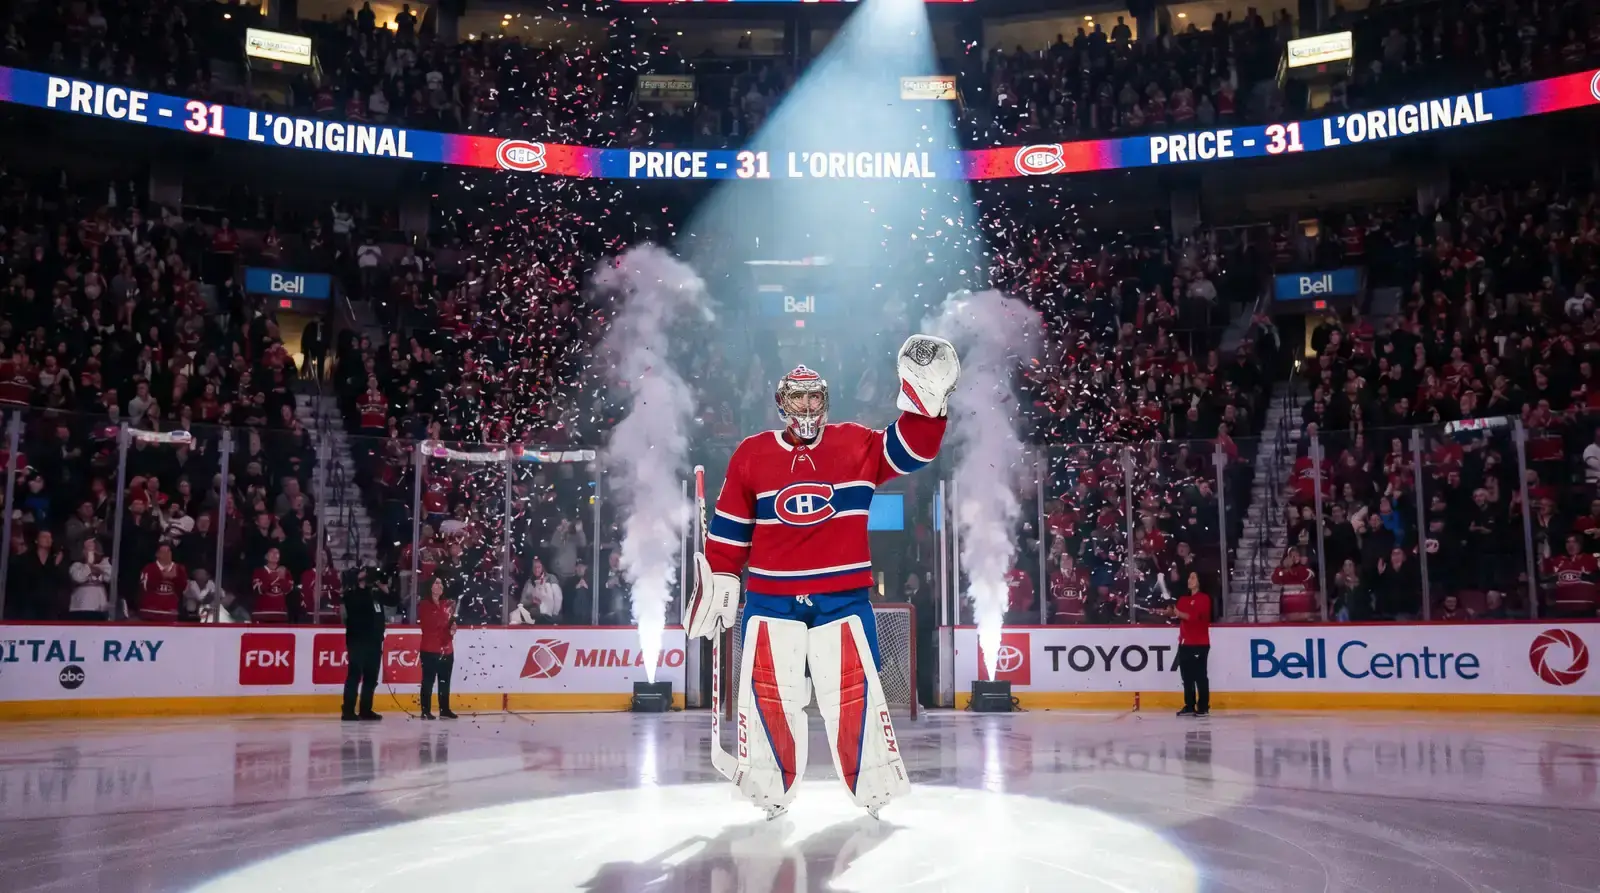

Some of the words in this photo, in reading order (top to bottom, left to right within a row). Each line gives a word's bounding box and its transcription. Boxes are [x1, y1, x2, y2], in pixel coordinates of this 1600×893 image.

[47, 77, 149, 123] PRICE
[185, 100, 226, 137] 31
[248, 111, 414, 159] L’ORIGINAL
[1150, 129, 1235, 164] PRICE
[1264, 121, 1304, 155] 31
[1322, 92, 1493, 147] L’ORIGINAL
[629, 151, 708, 178] PRICE
[735, 150, 771, 179] 31
[788, 151, 936, 179] L’ORIGINAL
[270, 273, 305, 294] Bell
[1299, 274, 1333, 295] Bell
[783, 295, 816, 313] Bell
[0, 639, 85, 663] ITAL
[103, 639, 164, 663] RAY
[244, 650, 290, 668] FDK
[1250, 638, 1327, 679] Bell
[1337, 639, 1481, 680] Centre
[59, 670, 85, 682] abc
[738, 712, 748, 758] CCM
[879, 710, 898, 753] CCM
